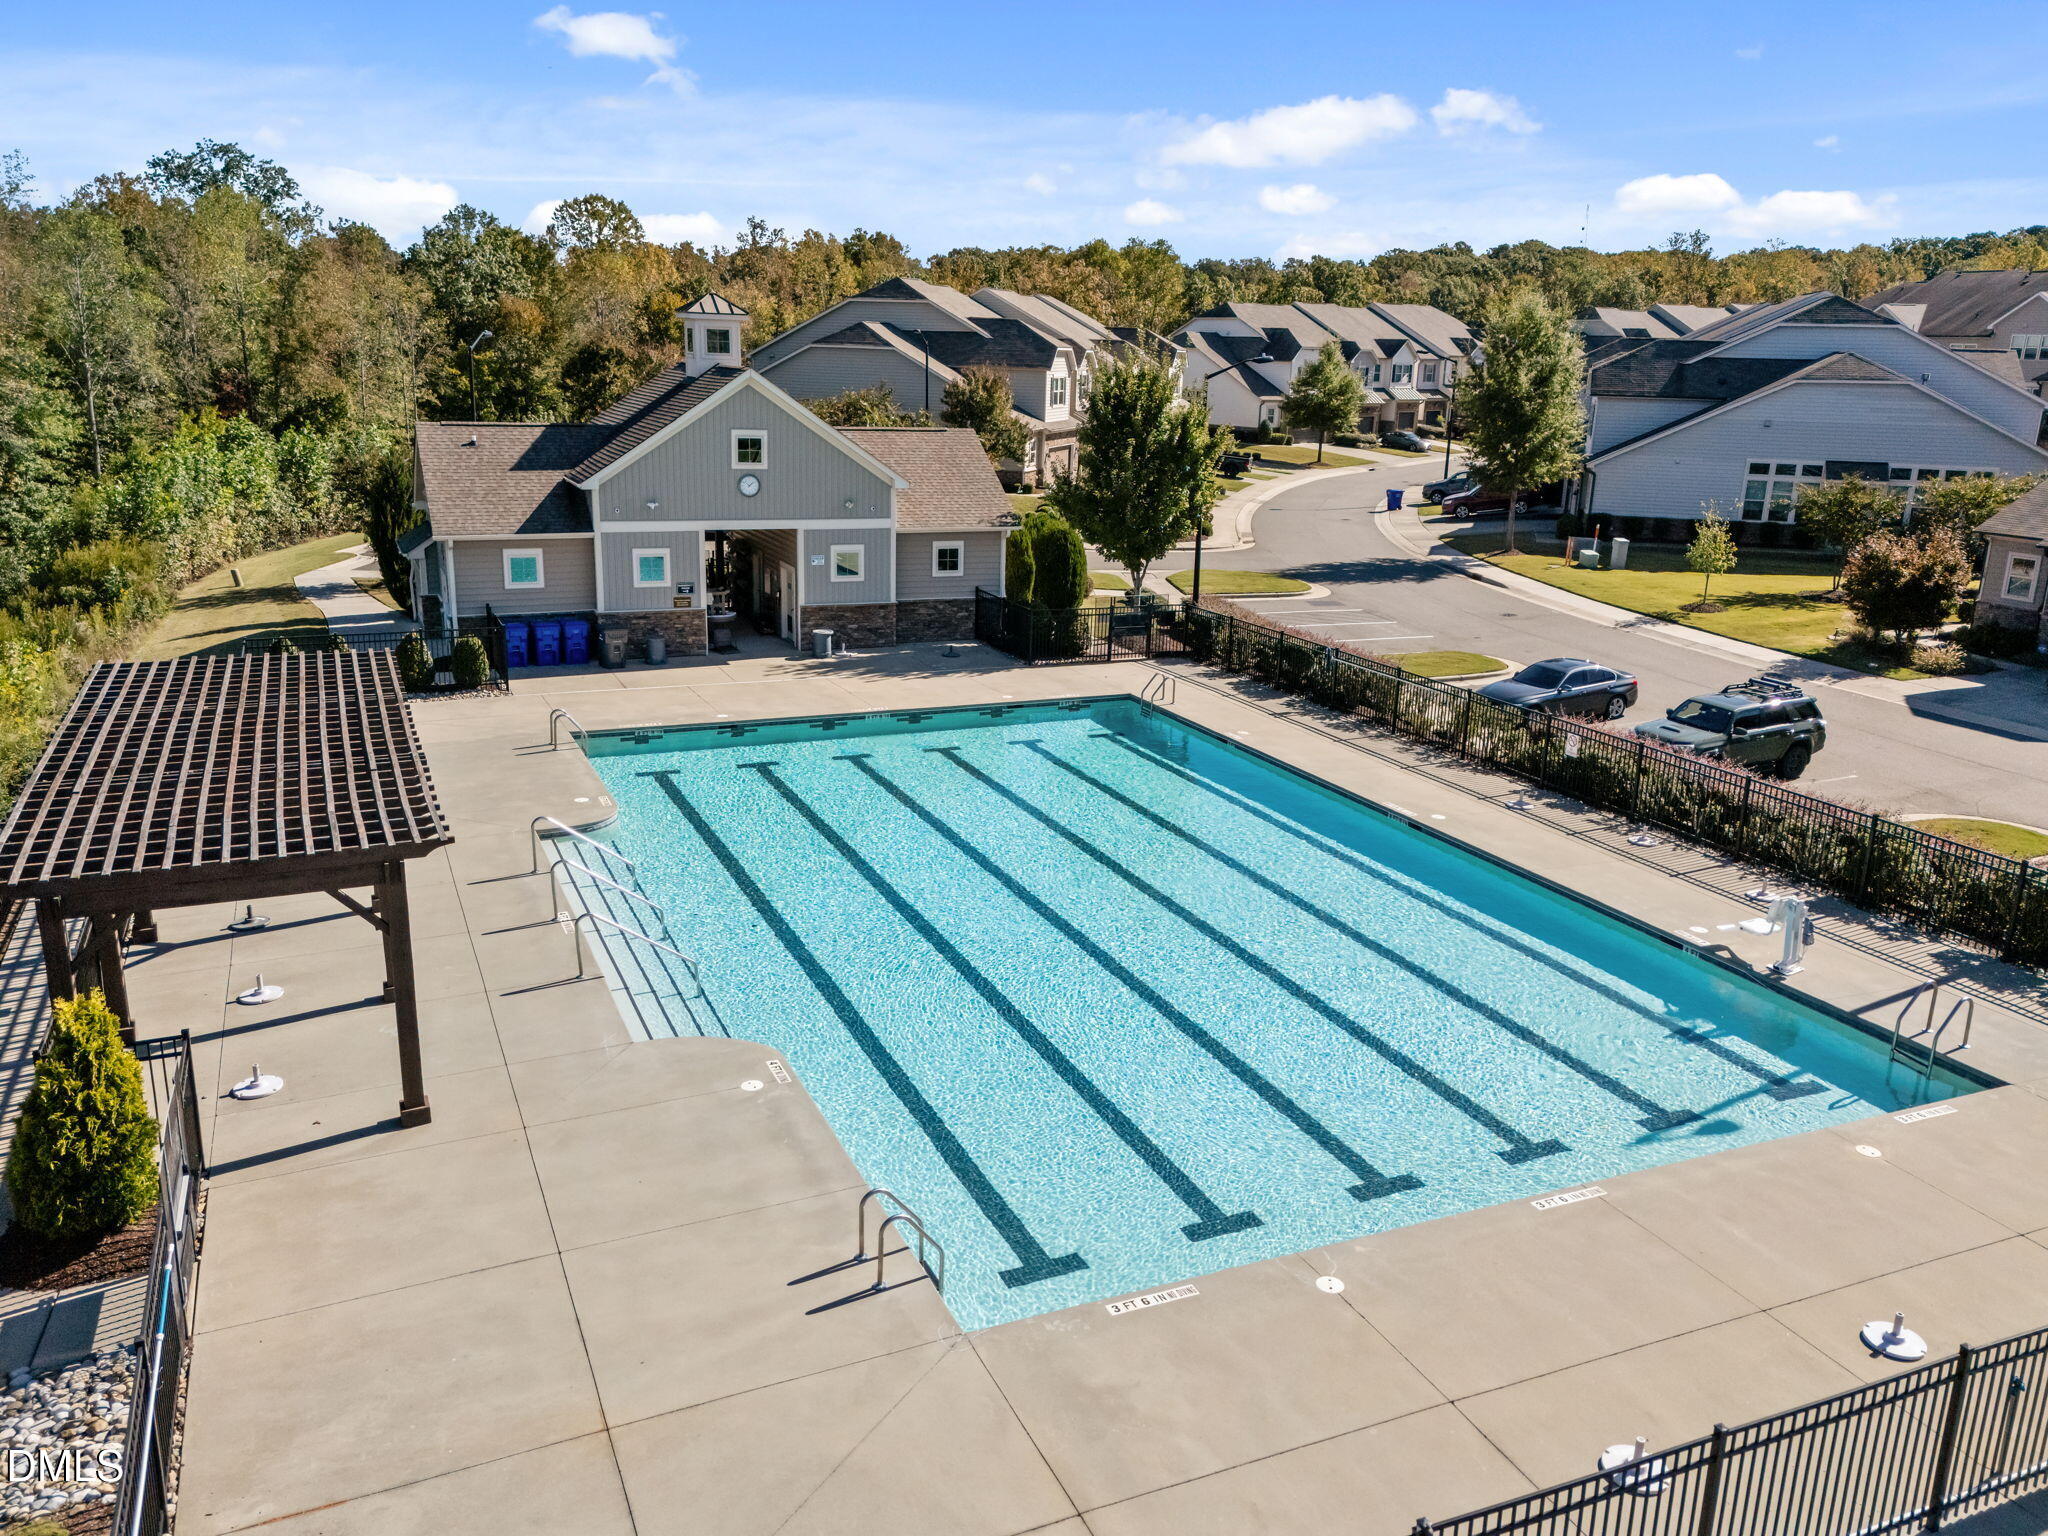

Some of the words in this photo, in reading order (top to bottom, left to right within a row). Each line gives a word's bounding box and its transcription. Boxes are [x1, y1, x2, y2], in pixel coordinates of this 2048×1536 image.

[1545, 1198, 1558, 1206] FT
[1111, 1304, 1121, 1313] 3
[1122, 1300, 1137, 1310] FT
[1140, 1297, 1151, 1305] 6
[1152, 1292, 1167, 1302] IN
